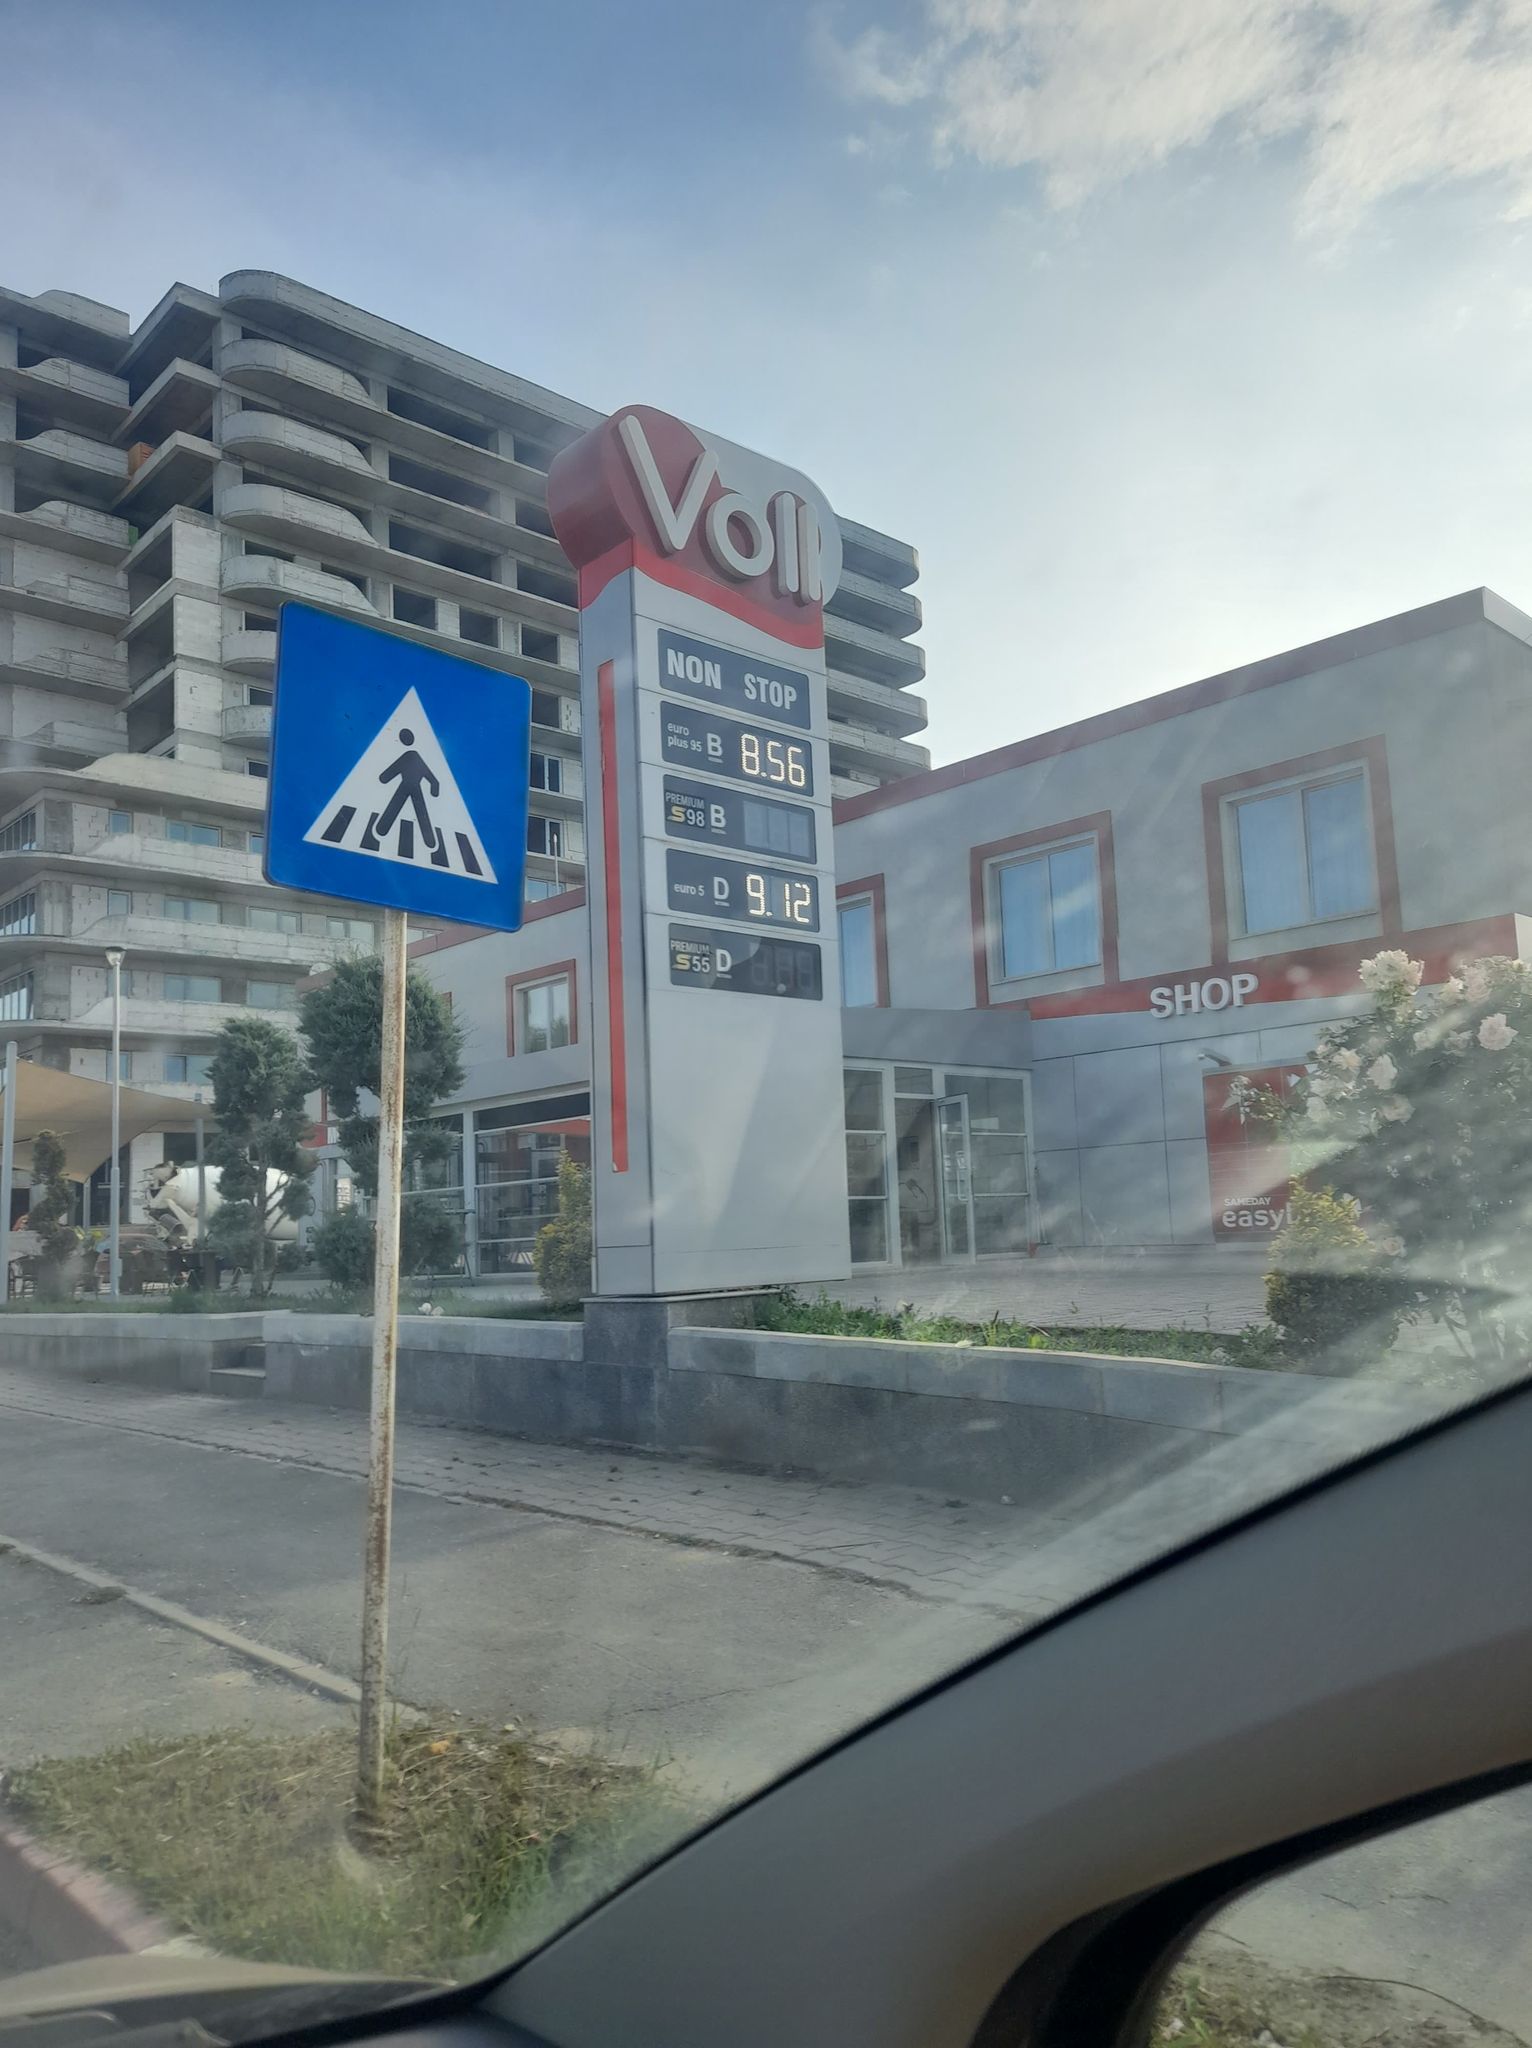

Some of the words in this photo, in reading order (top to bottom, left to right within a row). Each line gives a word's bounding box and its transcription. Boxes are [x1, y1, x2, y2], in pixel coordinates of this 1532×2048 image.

[618, 414, 822, 601] Voll
[666, 648, 722, 690] NON
[744, 673, 797, 710] STOP
[667, 722, 690, 737] euro
[667, 735, 689, 749] plus
[689, 739, 703, 753] 95
[706, 732, 723, 757] B
[740, 732, 806, 788] 8.56
[665, 791, 705, 810] PREMIUM
[710, 803, 727, 829] B
[673, 882, 697, 896] euro
[698, 885, 705, 897] 5
[713, 876, 730, 901] D
[745, 873, 812, 924] 9.12
[670, 939, 711, 955] PREMIUM
[715, 948, 732, 973] D
[1150, 973, 1259, 1019] SHOP
[1223, 1196, 1272, 1207] SAMEDAY
